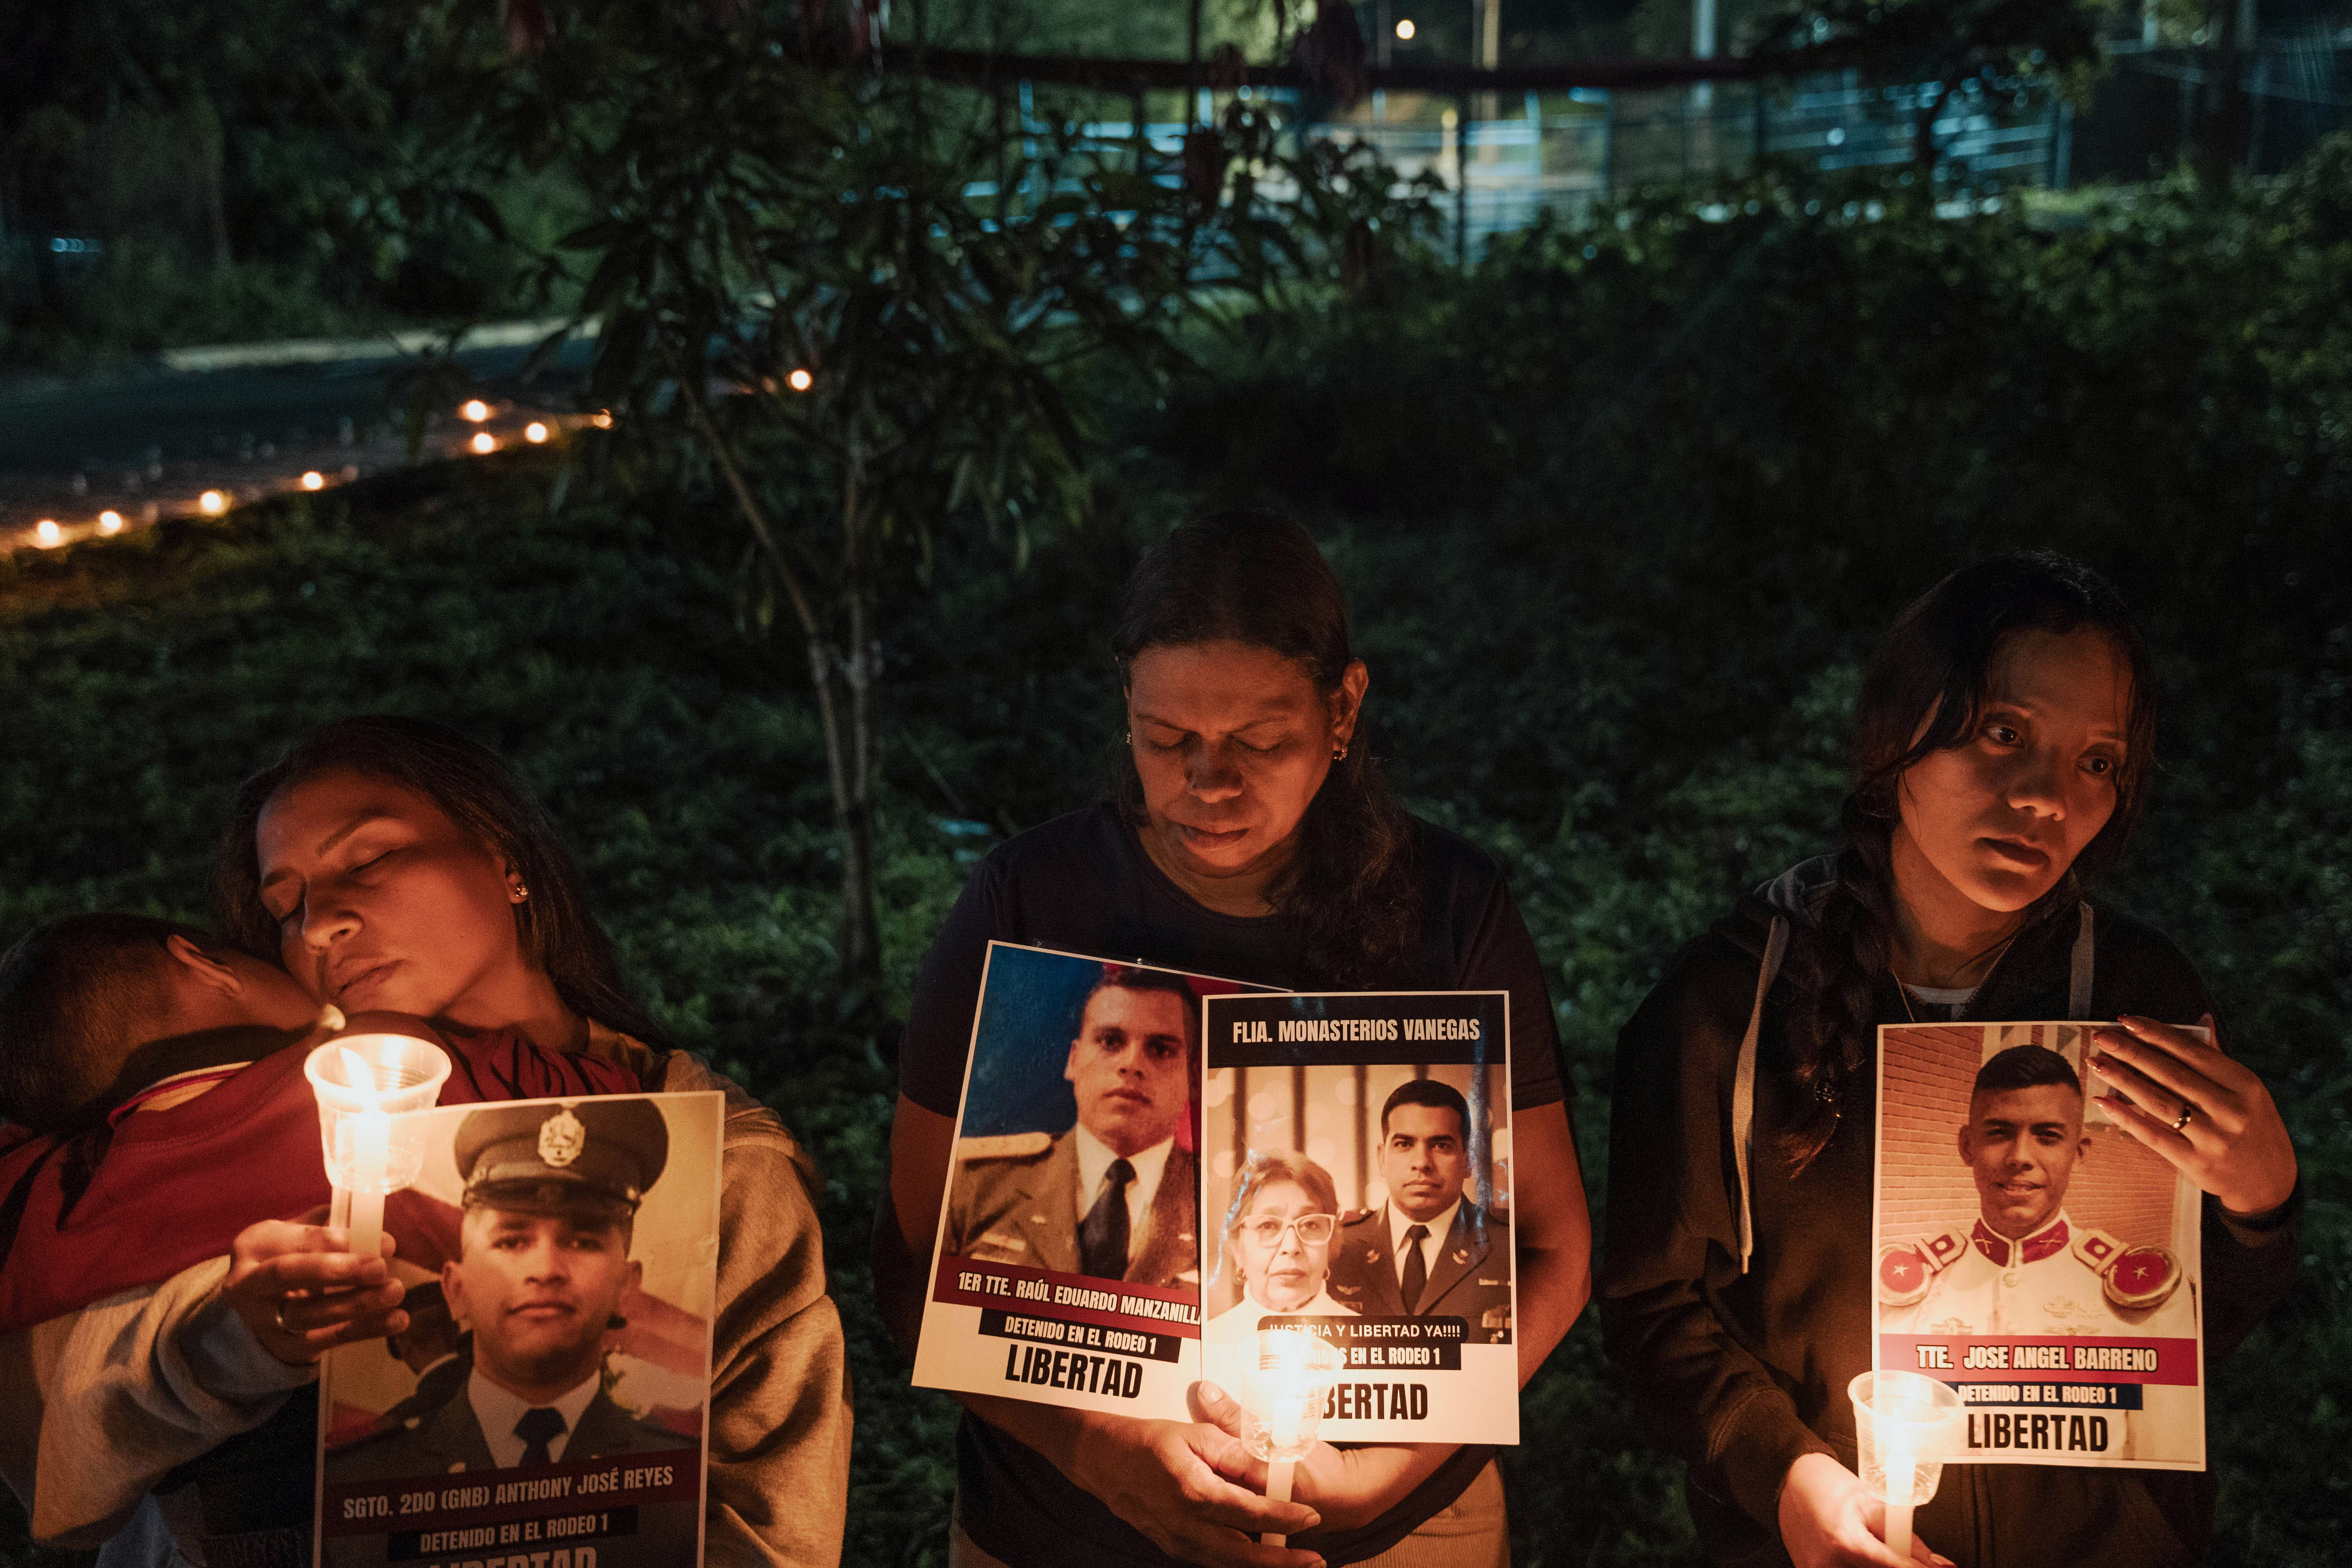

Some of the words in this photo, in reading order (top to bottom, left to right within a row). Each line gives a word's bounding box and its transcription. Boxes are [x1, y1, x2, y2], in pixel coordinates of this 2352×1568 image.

[1233, 1021, 1273, 1043] FLIA.
[1278, 1019, 1398, 1042] MONASTERIOS
[1403, 1018, 1480, 1040] VANEGAS
[958, 1272, 982, 1292] 1ER
[986, 1275, 1012, 1296] TTE.
[1015, 1278, 1050, 1302] RAÚL
[1054, 1285, 1118, 1312] EDUARDO
[1120, 1295, 1201, 1325] MANZANILL
[1005, 1316, 1065, 1340] DETENIDO
[1067, 1325, 1084, 1343] EN
[1087, 1328, 1101, 1346] EL
[1104, 1330, 1146, 1353] RODEO
[1150, 1337, 1157, 1355] 1
[1336, 1325, 1345, 1337] Y
[1350, 1325, 1420, 1337] LIBERTAD
[1424, 1325, 1460, 1337] YA!!!!
[1005, 1344, 1143, 1399] LIBERTAD
[1350, 1347, 1367, 1365] EN
[1370, 1347, 1385, 1365] EL
[1388, 1347, 1430, 1365] RODEO
[1433, 1347, 1440, 1365] 1
[1917, 1345, 1953, 1368] TTE.
[1964, 1346, 2009, 1369] JOSE
[2012, 1347, 2070, 1370] ANGEL
[2074, 1347, 2157, 1372] BARRENO
[1319, 1383, 1428, 1420] BERTAD
[1958, 1385, 2020, 1402] DETENIDO
[2022, 1385, 2040, 1402] EN
[2043, 1386, 2059, 1402] EL
[2062, 1386, 2106, 1404] RODEO
[2109, 1387, 2117, 1404] 1
[1967, 1414, 2108, 1452] LIBERTAD
[343, 1495, 394, 1519] SGTO.
[399, 1491, 436, 1515] 2DO
[442, 1486, 490, 1510] (GNB)
[495, 1476, 573, 1504] ANTHONY
[576, 1466, 619, 1494] JOSÉ
[624, 1466, 673, 1489] REYES
[420, 1527, 495, 1553] DETENIDO
[499, 1524, 520, 1543] EN
[524, 1521, 542, 1540] EL
[546, 1515, 596, 1537] RODEO
[600, 1513, 608, 1531] 1
